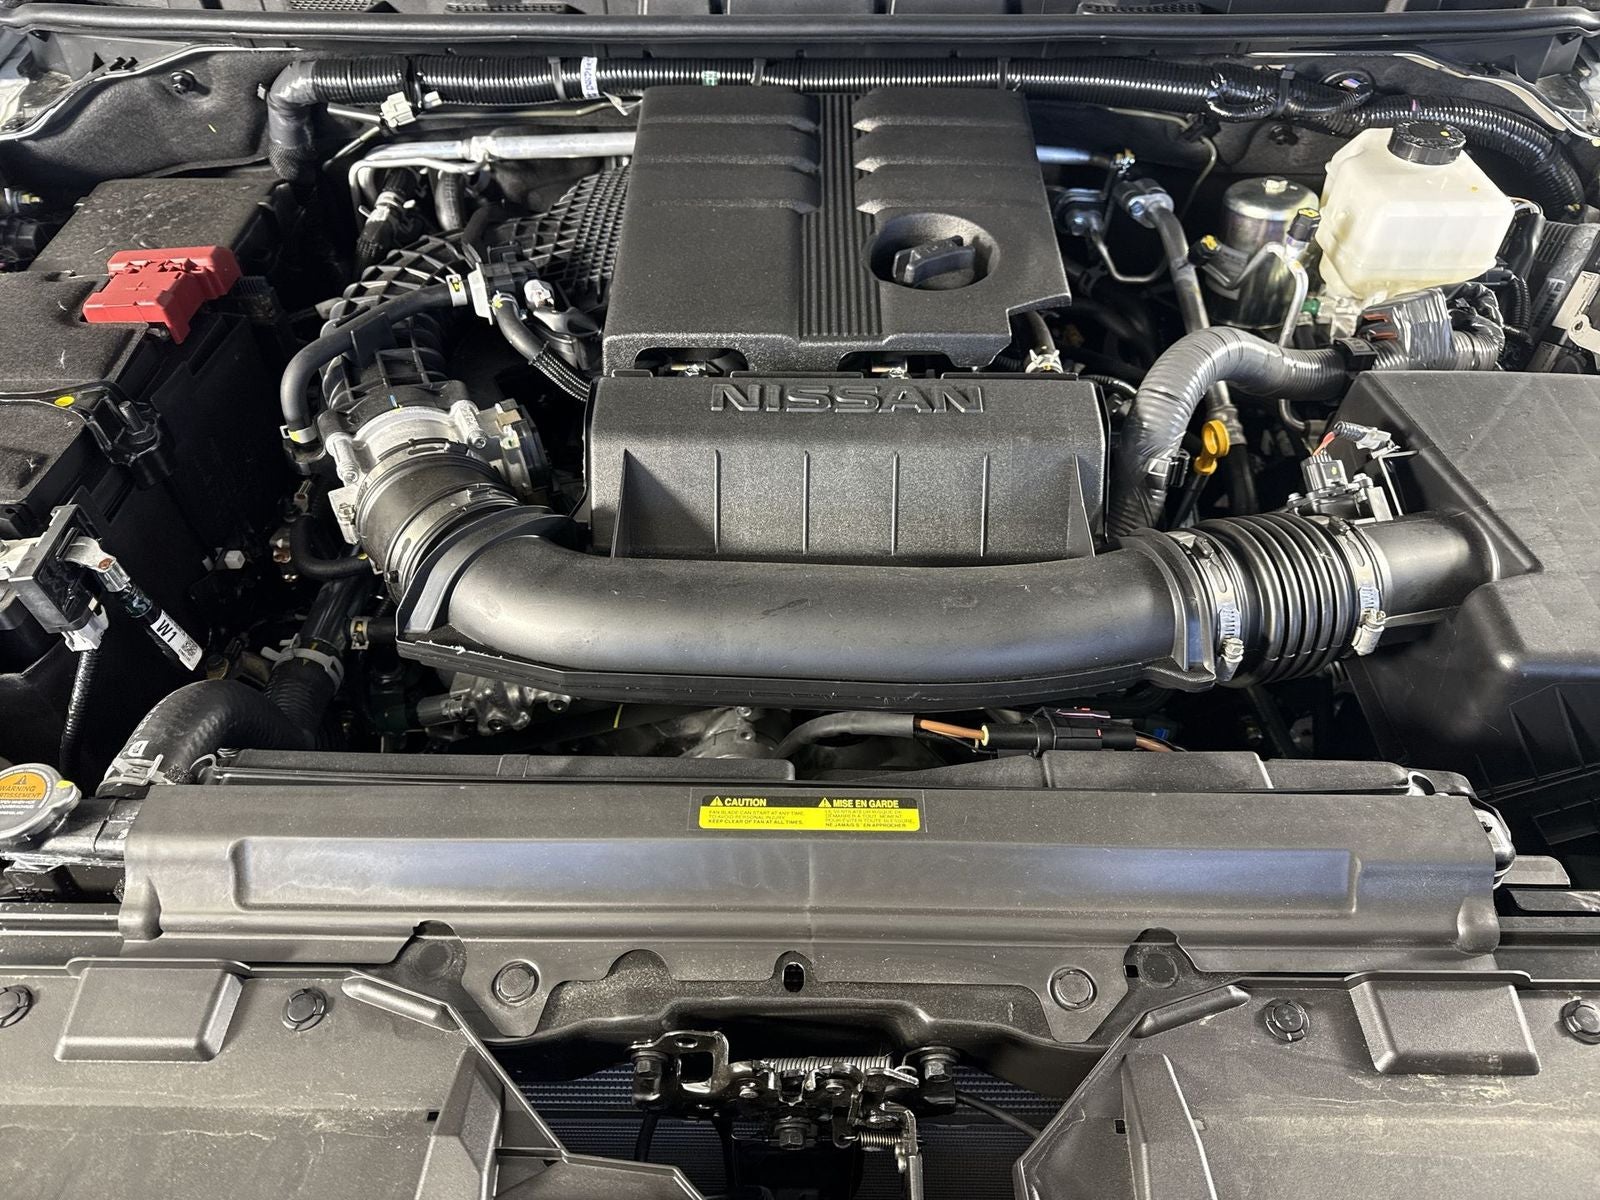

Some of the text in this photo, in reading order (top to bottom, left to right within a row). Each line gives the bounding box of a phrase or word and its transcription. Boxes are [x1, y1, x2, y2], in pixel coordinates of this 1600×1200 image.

[711, 384, 984, 413] NISSAN
[156, 619, 177, 643] W1
[724, 798, 767, 807] CAUTION
[832, 799, 899, 808] MISE EN GARDE
